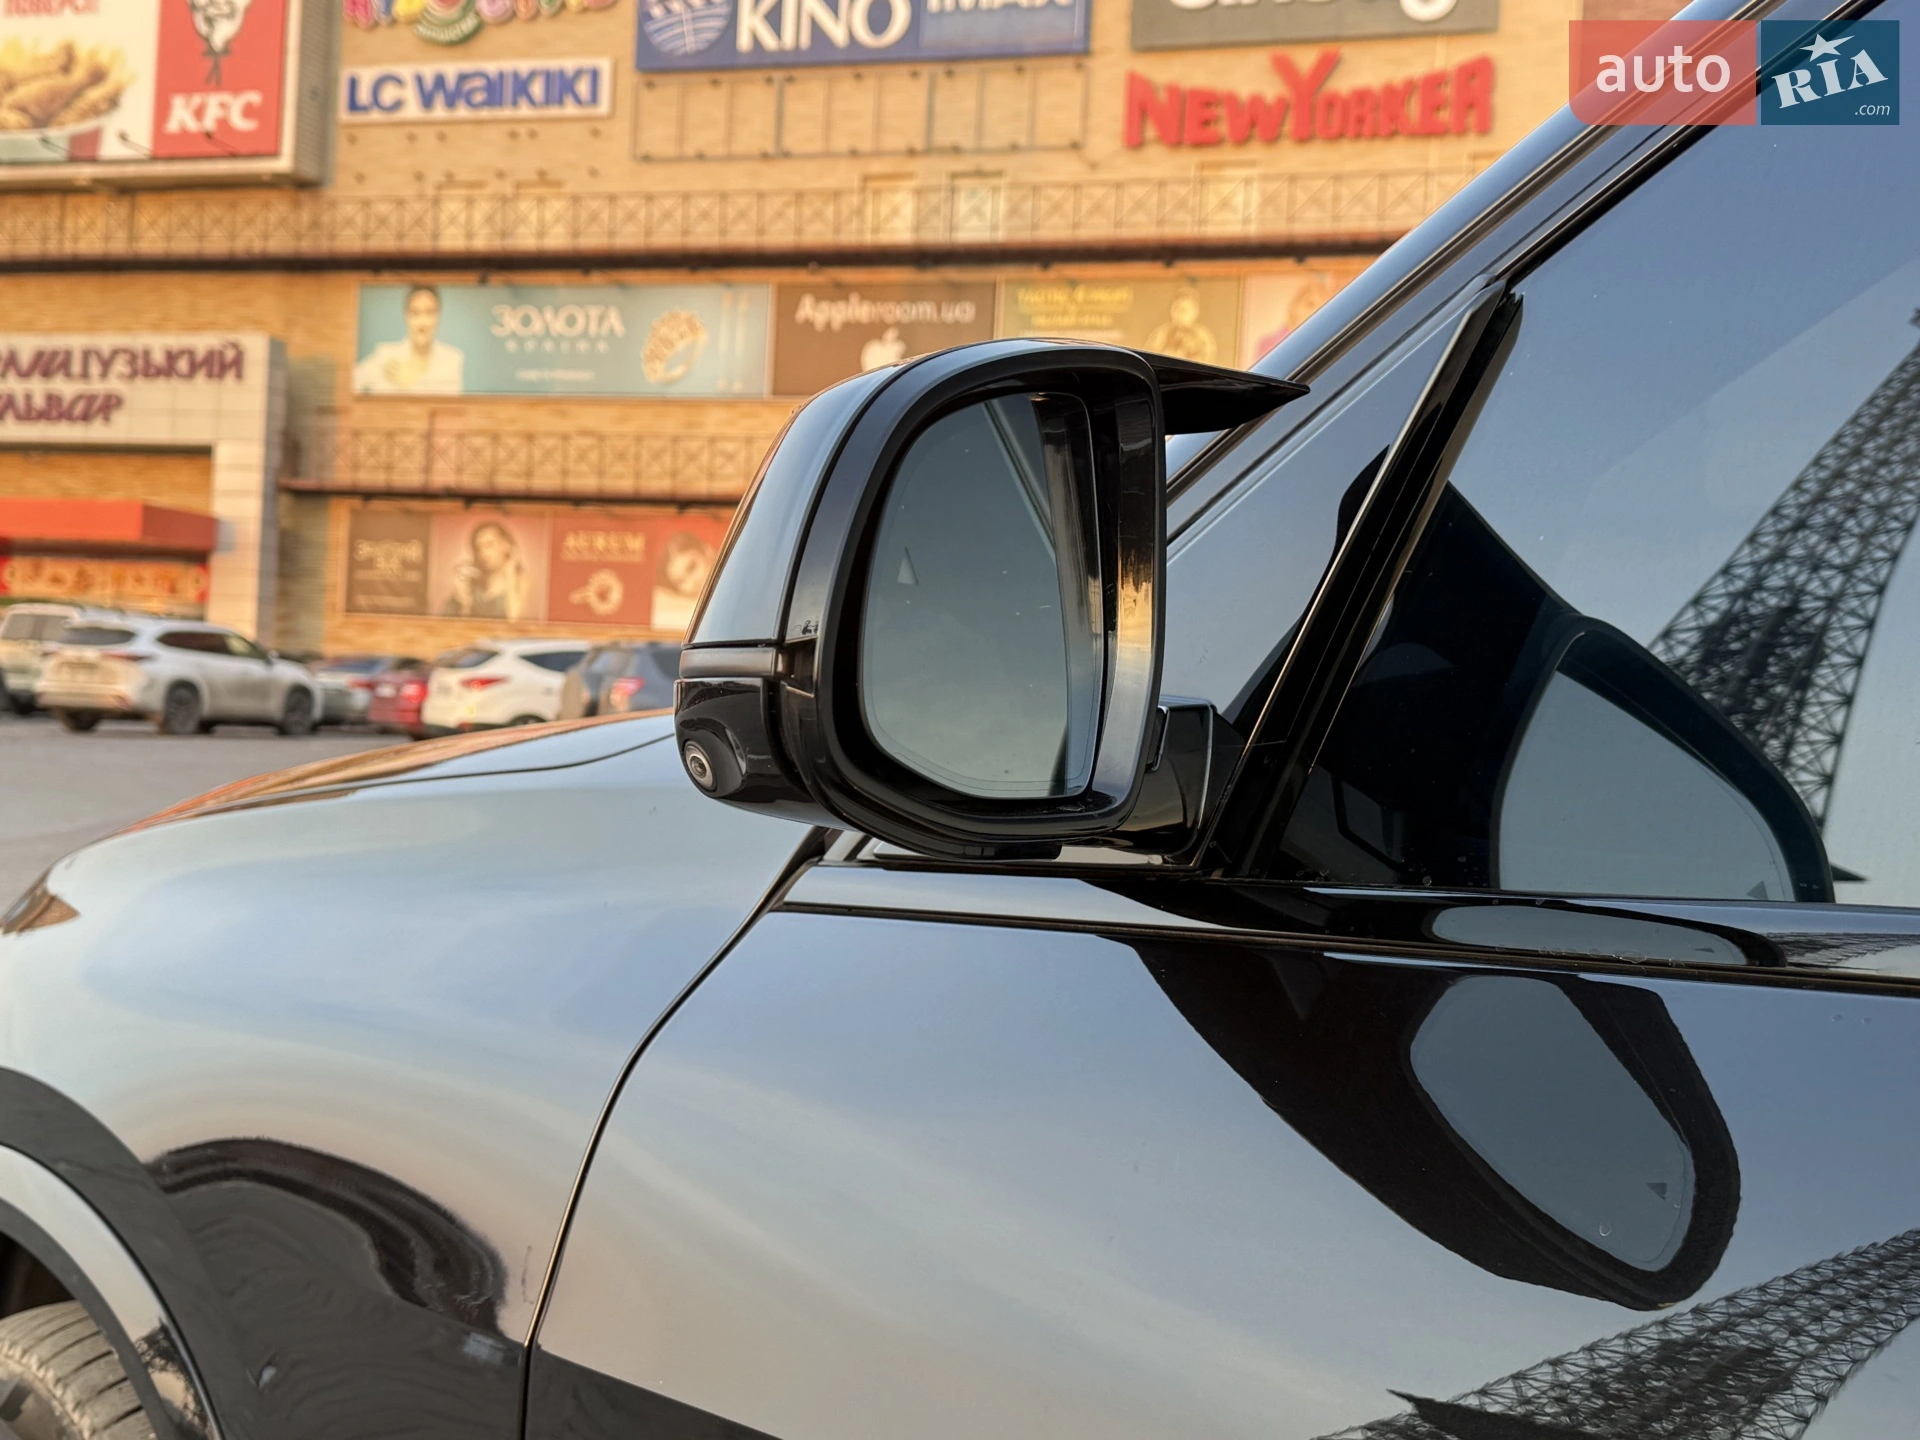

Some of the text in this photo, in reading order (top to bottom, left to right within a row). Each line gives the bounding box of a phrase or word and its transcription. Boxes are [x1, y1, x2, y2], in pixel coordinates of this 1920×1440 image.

[735, 0, 913, 51] KINO
[164, 90, 262, 133] KFC
[347, 73, 405, 113] LC
